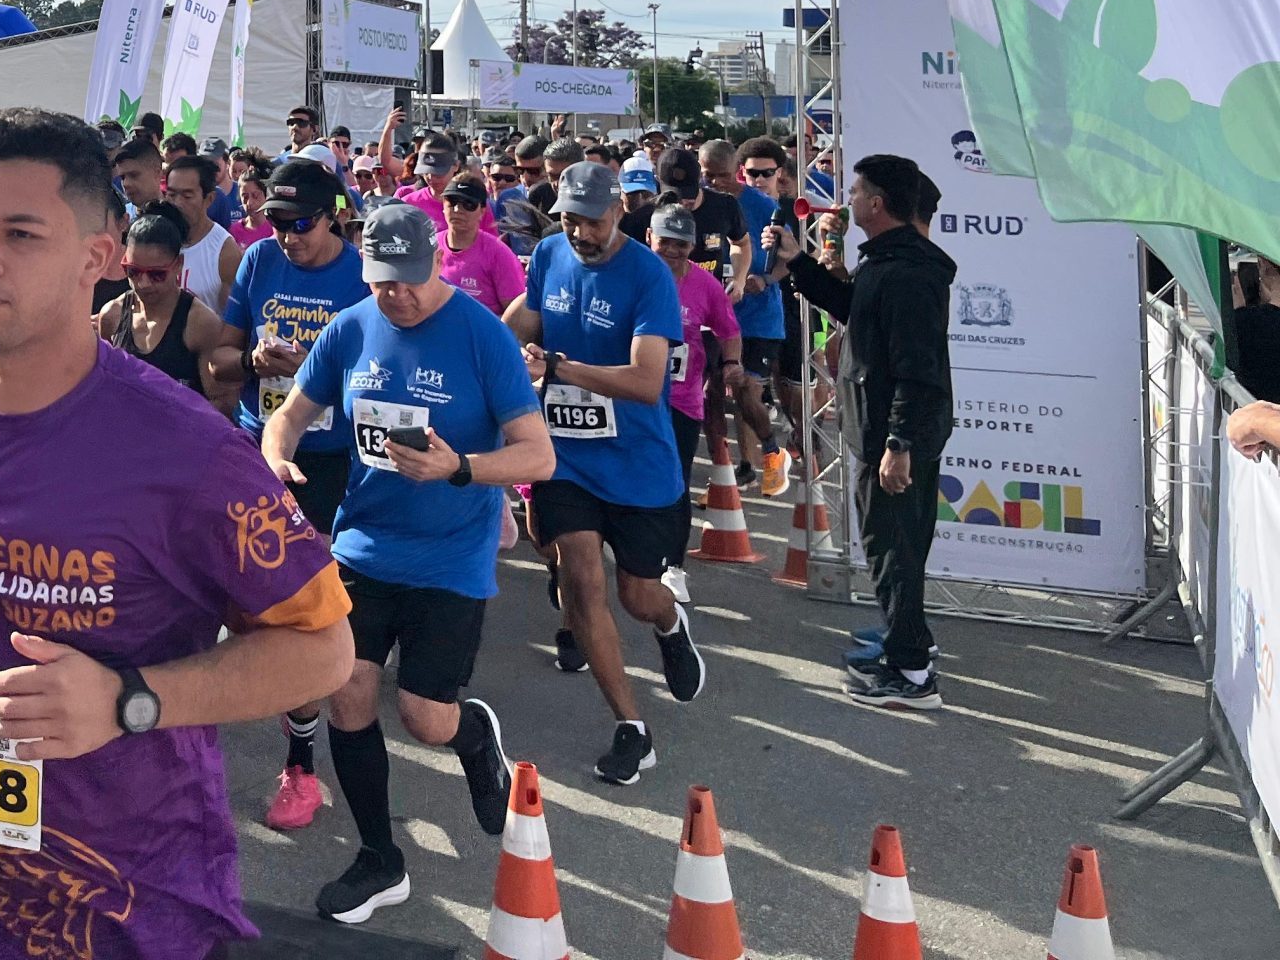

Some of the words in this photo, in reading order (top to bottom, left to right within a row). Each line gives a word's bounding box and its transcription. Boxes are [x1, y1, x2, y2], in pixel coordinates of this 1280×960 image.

[193, 3, 217, 24] RUD
[120, 8, 138, 63] Niterra
[359, 27, 381, 48] POSTO
[535, 78, 612, 96] PÓS-CHEGADA
[965, 215, 1024, 236] RUD
[947, 333, 966, 342] OGI
[968, 334, 987, 344] DAS
[988, 336, 1026, 346] CRUZES
[263, 392, 286, 411] 62
[958, 398, 1029, 415] ISTÉRIO
[1039, 405, 1063, 417] DO
[553, 406, 599, 427] 1196
[953, 418, 1034, 433] ESPORTE
[362, 428, 385, 453] 13
[945, 456, 992, 470] ERNO
[1001, 461, 1082, 477] FEDERAL
[971, 533, 1084, 553] RECONSTRUÇÃO
[2, 598, 116, 632] SUZANO
